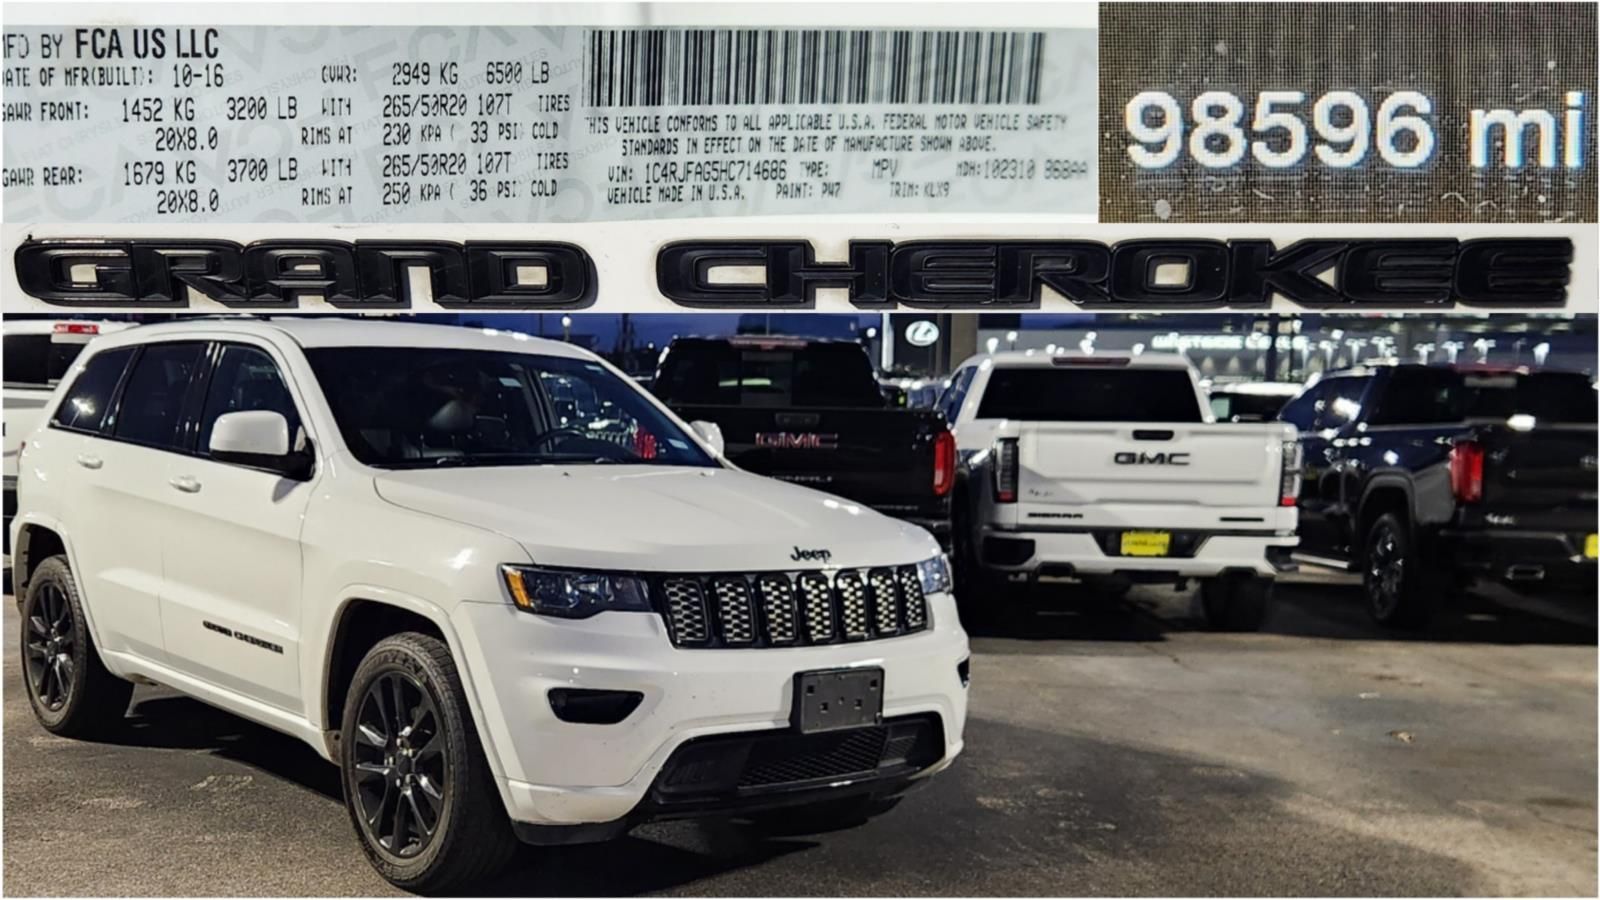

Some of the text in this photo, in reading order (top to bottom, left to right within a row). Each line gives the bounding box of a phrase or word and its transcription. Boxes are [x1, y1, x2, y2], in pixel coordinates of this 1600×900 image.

[41, 34, 62, 59] BY
[75, 27, 123, 59] FCA
[133, 28, 166, 59] US
[176, 28, 218, 59] LLC
[3, 67, 30, 87] ATE
[40, 67, 55, 86] OF
[174, 63, 223, 88] 10-16
[393, 62, 430, 85] 2949
[440, 62, 458, 85] KG
[486, 62, 522, 84] 6500
[532, 61, 549, 84] LB
[41, 101, 88, 121] FRONT:
[123, 98, 163, 122] 1452
[174, 97, 194, 121] KG
[227, 96, 267, 120] 3200
[278, 96, 297, 119] LB
[383, 94, 467, 118] 265/50R20
[479, 93, 512, 116] 107T
[539, 94, 570, 112] TIRES
[156, 126, 218, 151] 20X8.0
[302, 127, 330, 145] RIMS
[339, 126, 352, 143] AT
[383, 123, 411, 146] 230
[421, 124, 441, 142] KPA
[471, 121, 488, 143] 33
[532, 122, 558, 139] COLD
[616, 115, 660, 134] VEHICLE
[667, 115, 718, 132] CONFORMS
[726, 114, 737, 131] TO
[744, 115, 761, 131] ALL
[769, 113, 832, 131] APPLICABLE
[839, 113, 875, 130] U.S.A.
[884, 113, 927, 130] FEDERAL
[935, 113, 967, 130] MOTOR
[974, 114, 1020, 131] VEHICLE
[1126, 90, 1585, 170] 98596 mi
[622, 135, 996, 156] STANDARDS IN EFFECT ON THE DATE OF MANUFACTURE SHOWN ABOVE.
[3, 168, 34, 187] GAWR
[43, 166, 82, 186] REAR:
[125, 161, 164, 186] 1679
[176, 160, 196, 184] KG
[228, 158, 268, 182] 3700
[278, 157, 297, 181] LB
[383, 153, 466, 177] 265/50R20
[478, 151, 511, 175] 107T
[537, 152, 568, 170] TIRES
[608, 166, 632, 183] VIN:
[645, 160, 788, 184] 1C4RJFAG5HC714686
[872, 158, 898, 179] MPV
[157, 189, 219, 214] 20X8.0
[302, 187, 330, 205] RIMS
[339, 186, 352, 204] AT
[383, 182, 410, 205] 250
[420, 184, 440, 201] KPA
[470, 179, 487, 201] 36
[531, 179, 557, 197] COLD
[608, 181, 950, 204] VEHICLE MADE IN U.S.A. PAINT: PW7 TRIM: KLX9
[15, 235, 1575, 309] GRAND CHEROKEE
[755, 431, 838, 448] GMC
[1114, 452, 1191, 465] GMC
[790, 545, 832, 564] Jeep
